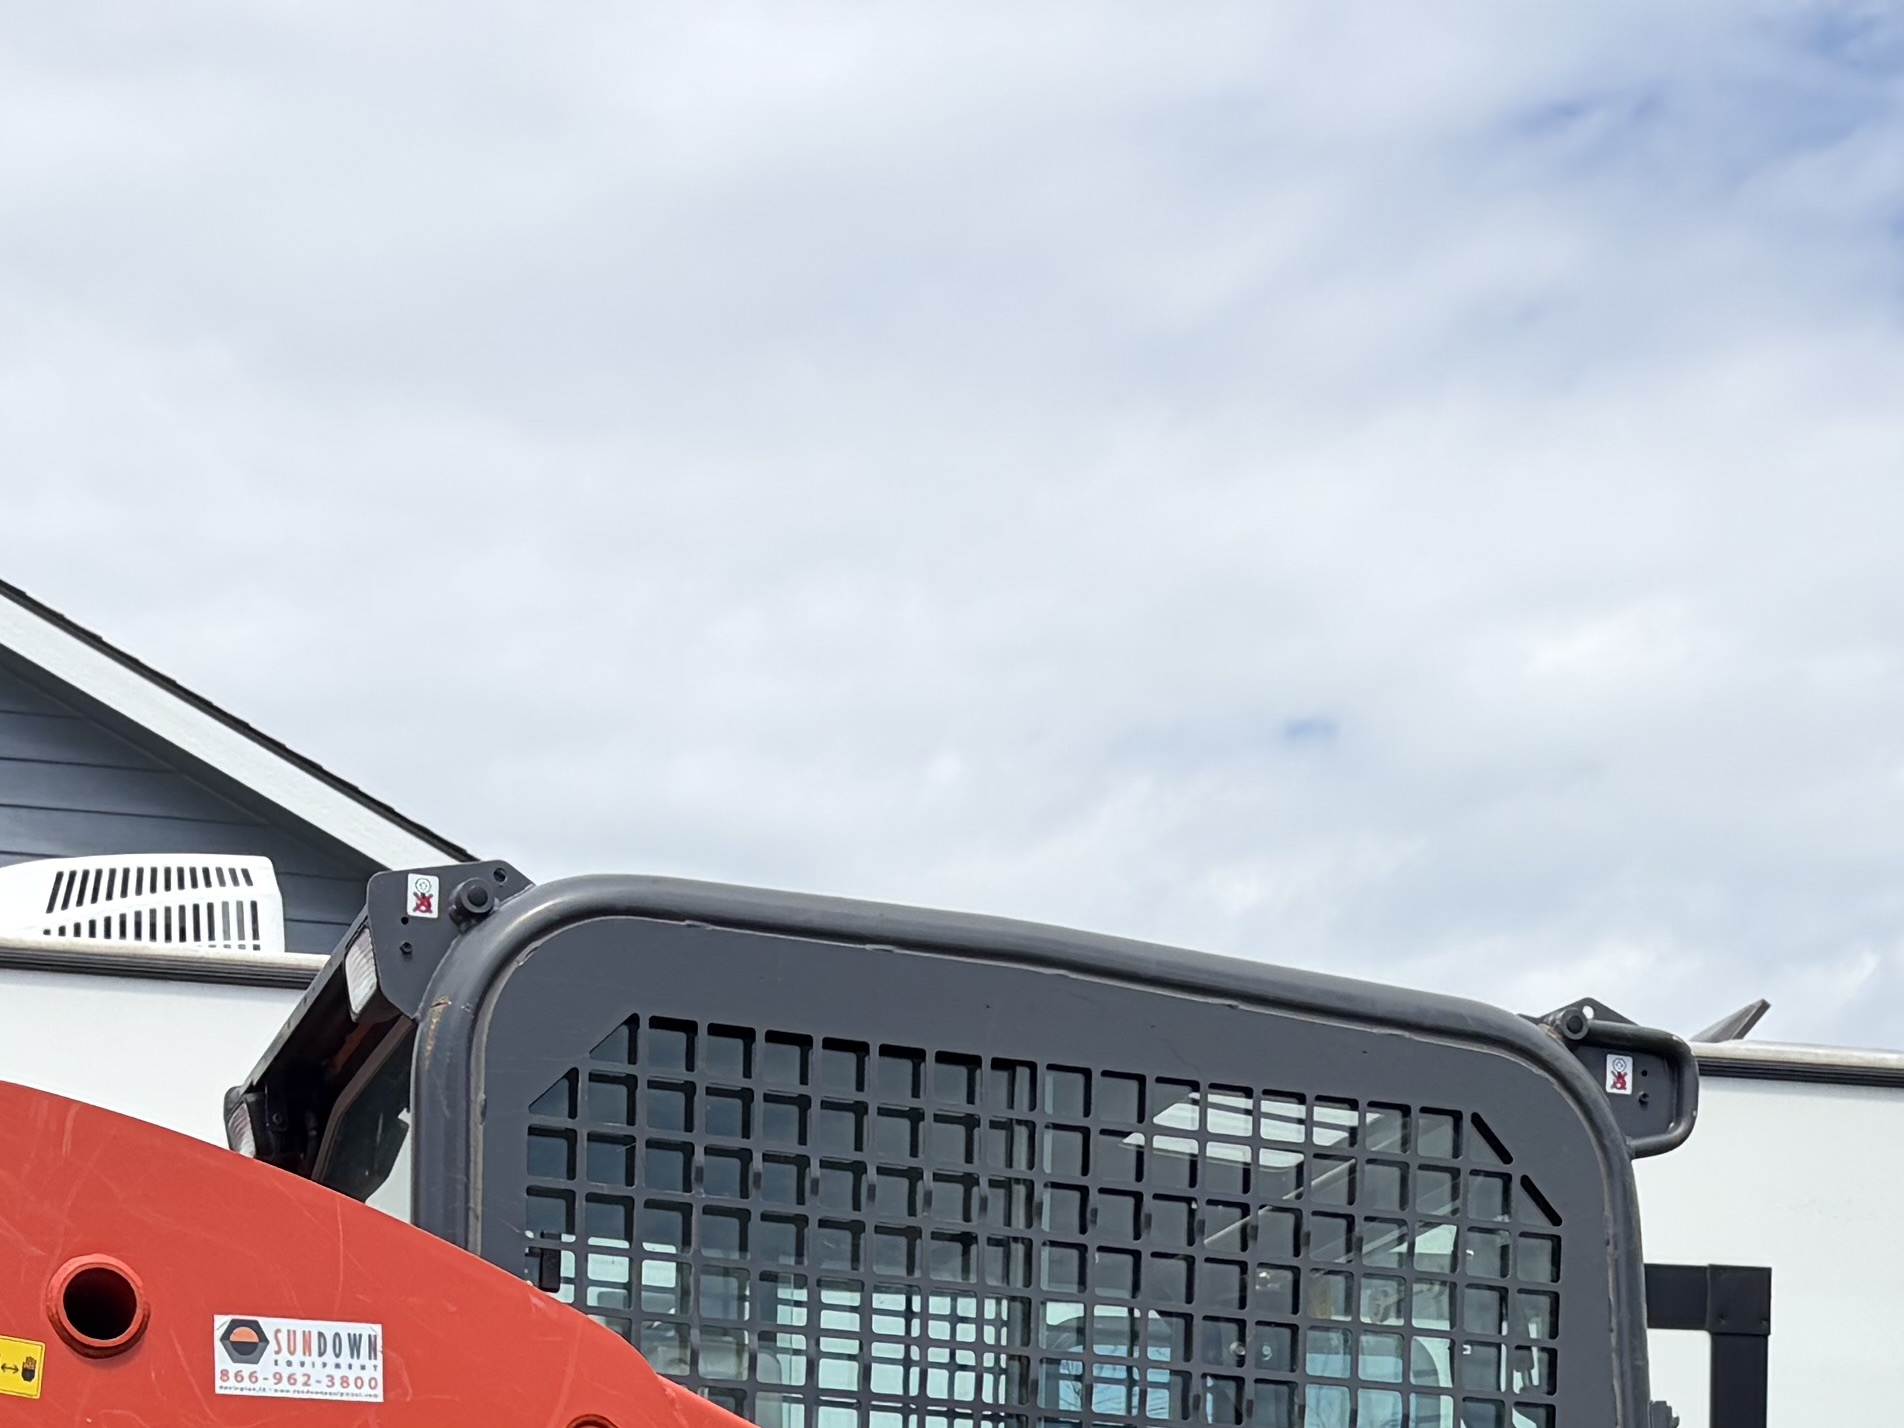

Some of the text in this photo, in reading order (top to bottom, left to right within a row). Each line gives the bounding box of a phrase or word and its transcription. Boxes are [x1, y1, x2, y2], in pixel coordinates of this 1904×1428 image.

[273, 1328, 378, 1361] SUNDOWN
[273, 1359, 379, 1372] EQUIPMENT
[219, 1369, 379, 1391] 866-962-3800
